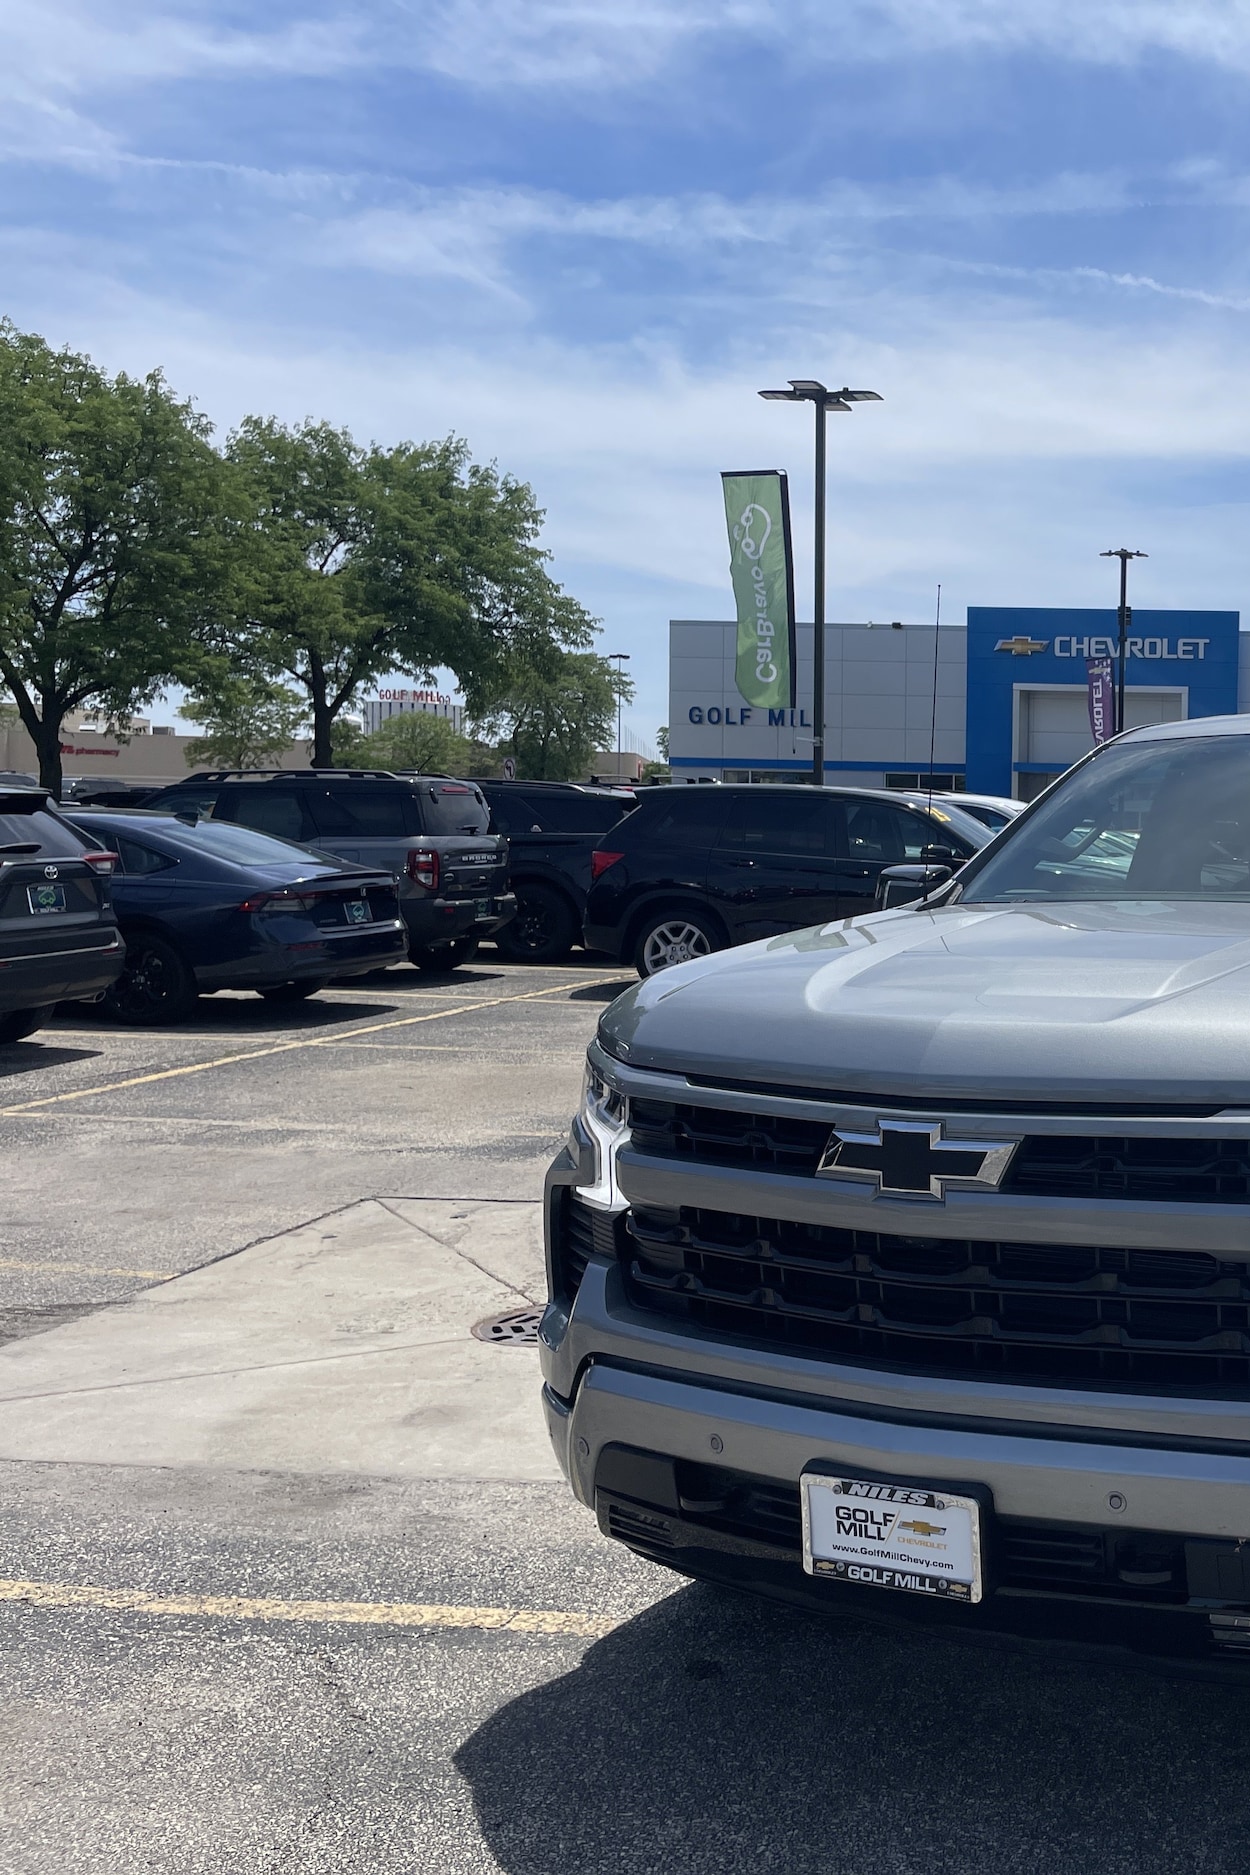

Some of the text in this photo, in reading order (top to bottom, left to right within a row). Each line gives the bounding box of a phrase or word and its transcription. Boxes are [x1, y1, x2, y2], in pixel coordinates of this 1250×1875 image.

[1054, 636, 1210, 660] CHEVROLET
[379, 689, 408, 701] GOLF
[688, 706, 812, 727] GOLF MIL
[848, 1482, 929, 1506] NILES
[835, 1505, 896, 1527] GOLF
[836, 1519, 886, 1541] MILL
[897, 1536, 948, 1551] CHEVROLET
[832, 1543, 954, 1570] www.GolfMillChevy.com
[847, 1564, 937, 1593] GOLF MILL
